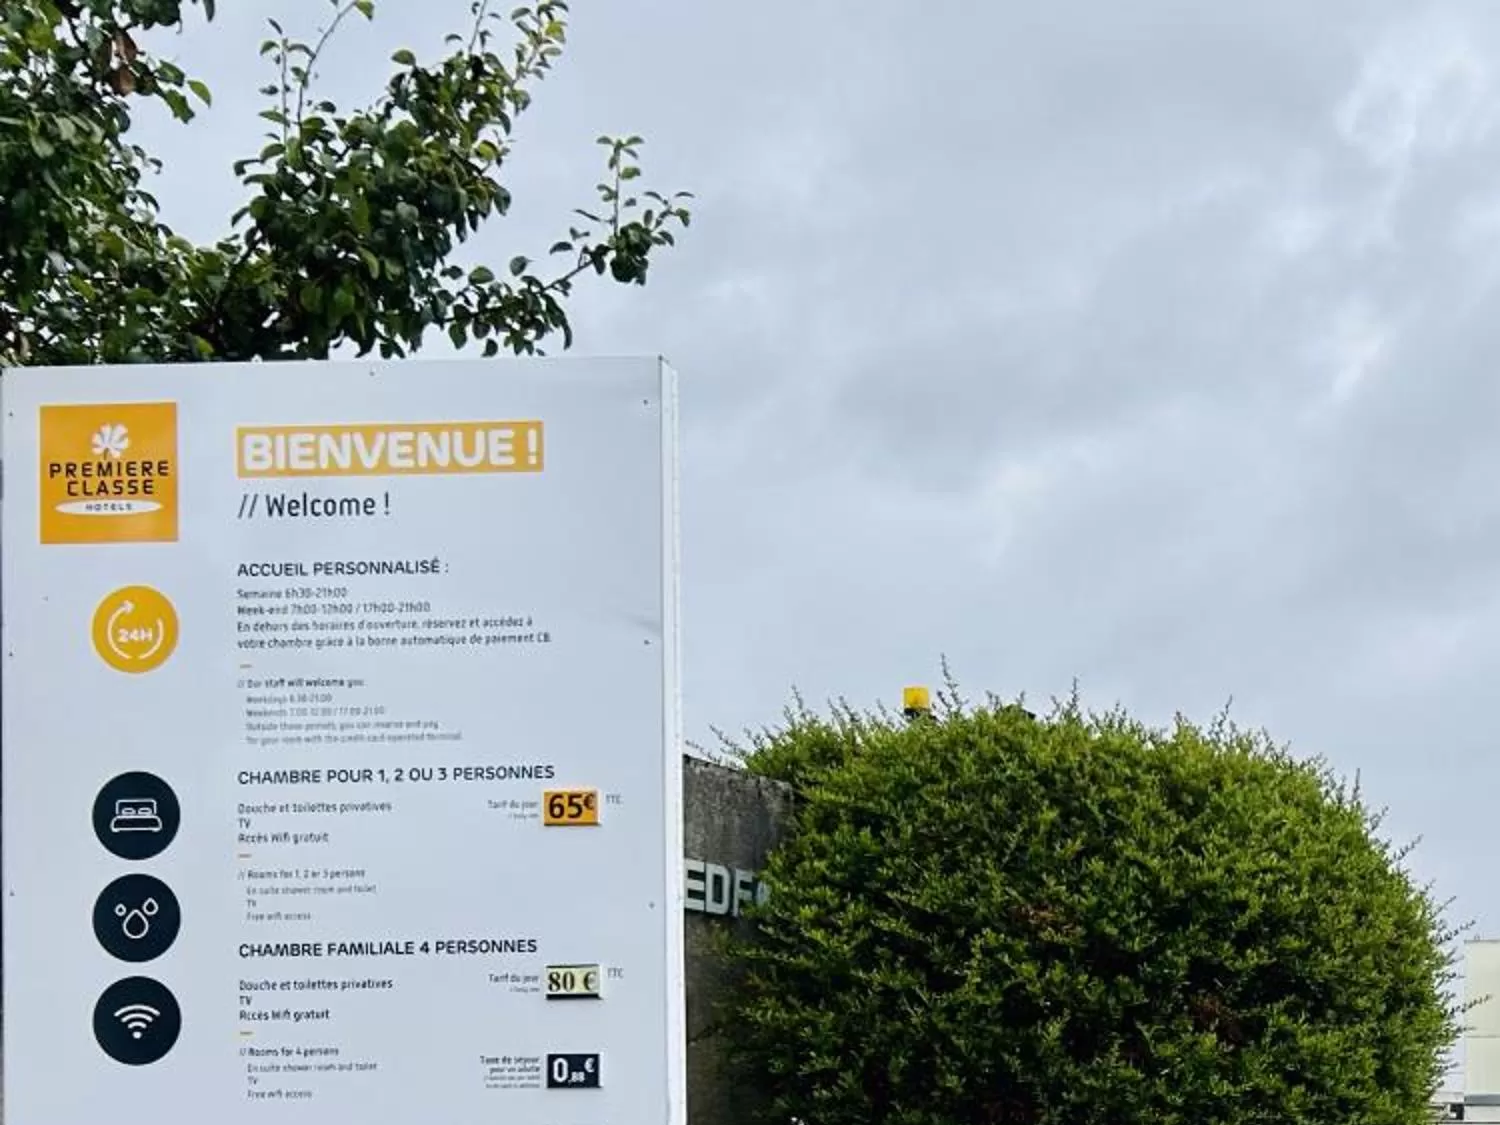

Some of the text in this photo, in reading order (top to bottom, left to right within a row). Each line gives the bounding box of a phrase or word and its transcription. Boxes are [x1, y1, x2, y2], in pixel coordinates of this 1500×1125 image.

[244, 429, 515, 469] BIENVENUE
[50, 460, 169, 478] PREMIERE
[67, 479, 154, 496] CLASSE
[86, 503, 132, 511] HOTELS
[266, 492, 375, 517] Welcome
[238, 563, 308, 576] ACCUEIL
[314, 558, 440, 575] PERSONNALISÉ
[118, 627, 152, 643] 24H
[238, 770, 321, 784] CHAMBRE
[327, 769, 373, 783] POUR
[409, 768, 433, 782] OU
[438, 768, 447, 780] 3
[453, 765, 554, 780] PERSONNES
[238, 818, 250, 829] TV
[239, 939, 537, 958] CHAMBRE FAMILIALE 4 PERSONNES
[548, 971, 575, 992] 80
[240, 996, 252, 1005] TV
